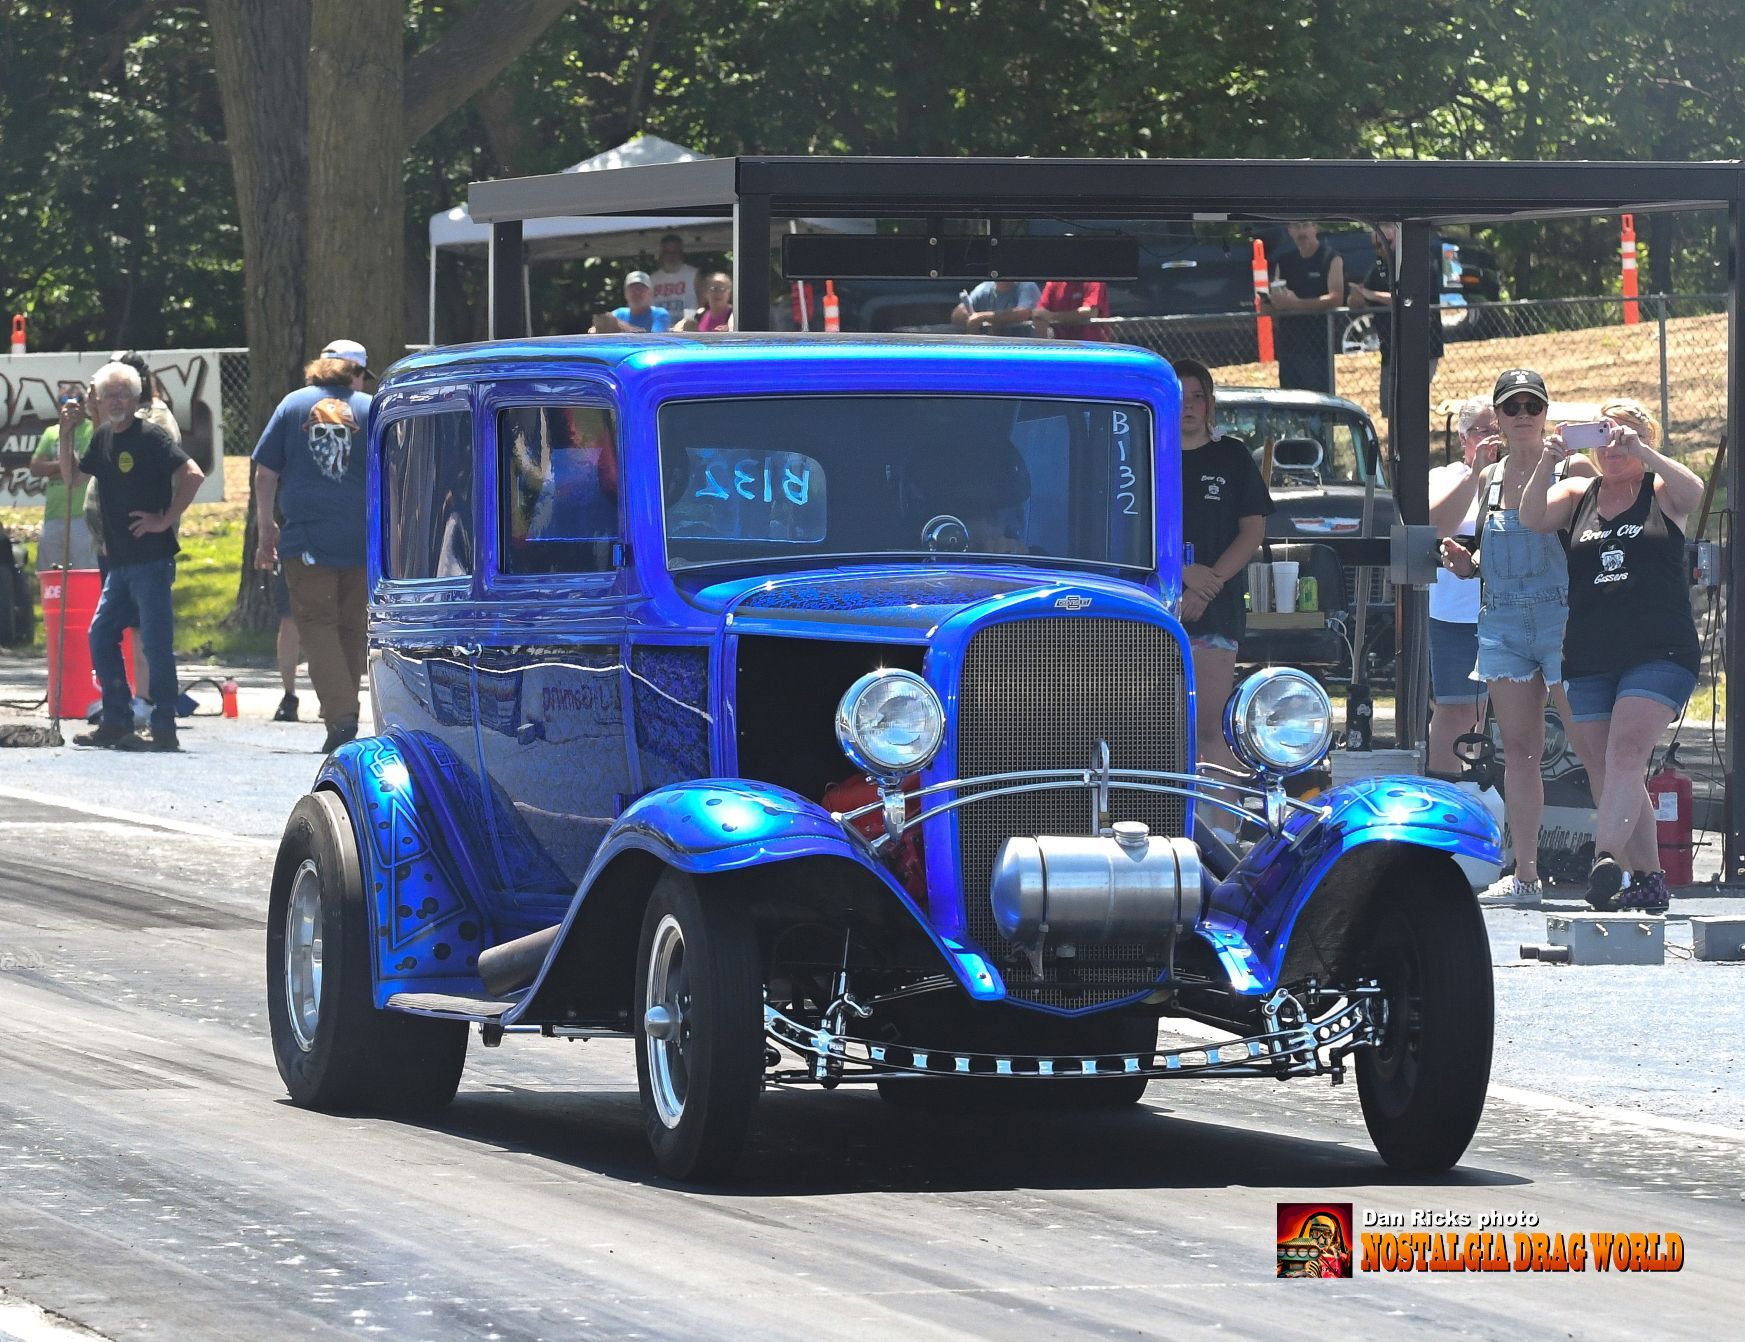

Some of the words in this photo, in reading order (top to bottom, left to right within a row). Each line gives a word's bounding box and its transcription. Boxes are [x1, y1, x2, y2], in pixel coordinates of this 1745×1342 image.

[1112, 410, 1139, 516] B132
[1579, 529, 1612, 543] Brew
[1616, 524, 1643, 539] City
[1593, 572, 1629, 585] Gassers
